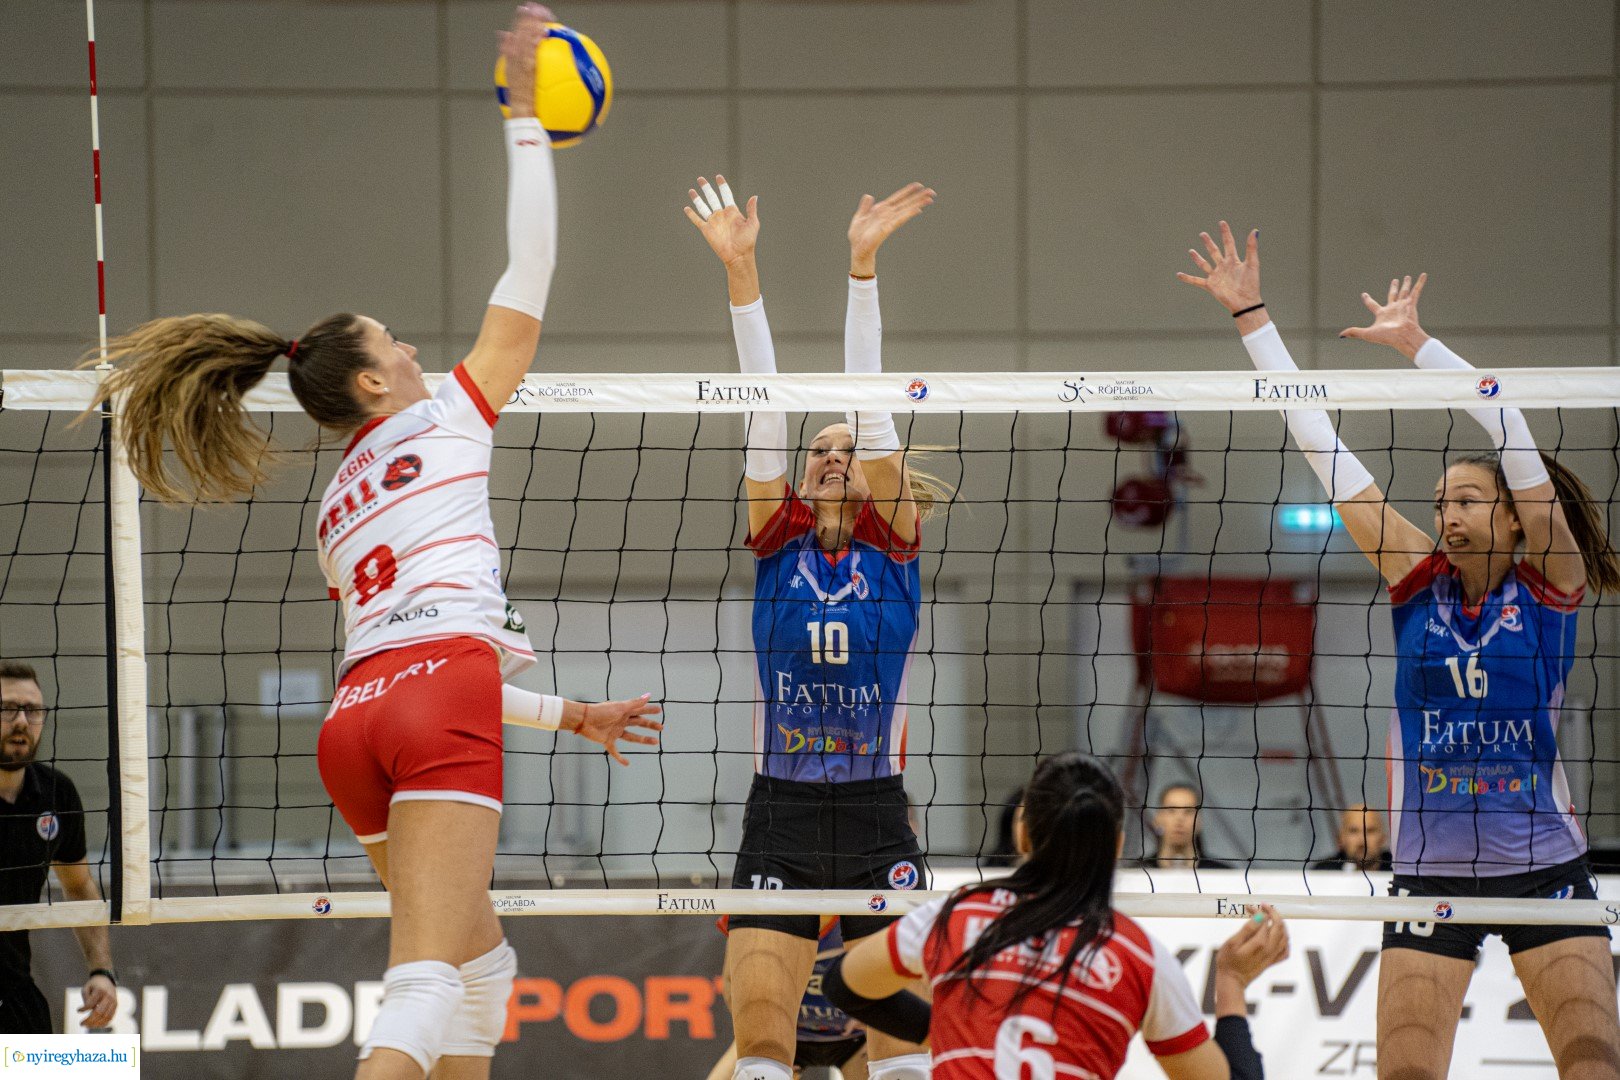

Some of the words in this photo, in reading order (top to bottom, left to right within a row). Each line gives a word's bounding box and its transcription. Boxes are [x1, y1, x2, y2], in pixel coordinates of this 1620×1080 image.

[538, 386, 594, 397] RÖPLABDA
[695, 378, 771, 401] FATUM
[1098, 385, 1154, 395] RÖPLABDA
[1252, 377, 1329, 399] FATUM
[338, 448, 376, 485] EGRI
[353, 543, 399, 608] 8
[806, 621, 849, 665] 10
[775, 670, 882, 711] FATUM
[1445, 651, 1489, 699] 16
[1422, 708, 1535, 745] FATUM
[491, 898, 536, 908] RÖPLABDA
[656, 892, 716, 910] FATUM
[1216, 897, 1275, 915] FAT
[500, 975, 724, 1043] POR
[993, 1014, 1059, 1080] 6
[1318, 1040, 1378, 1075] ZR
